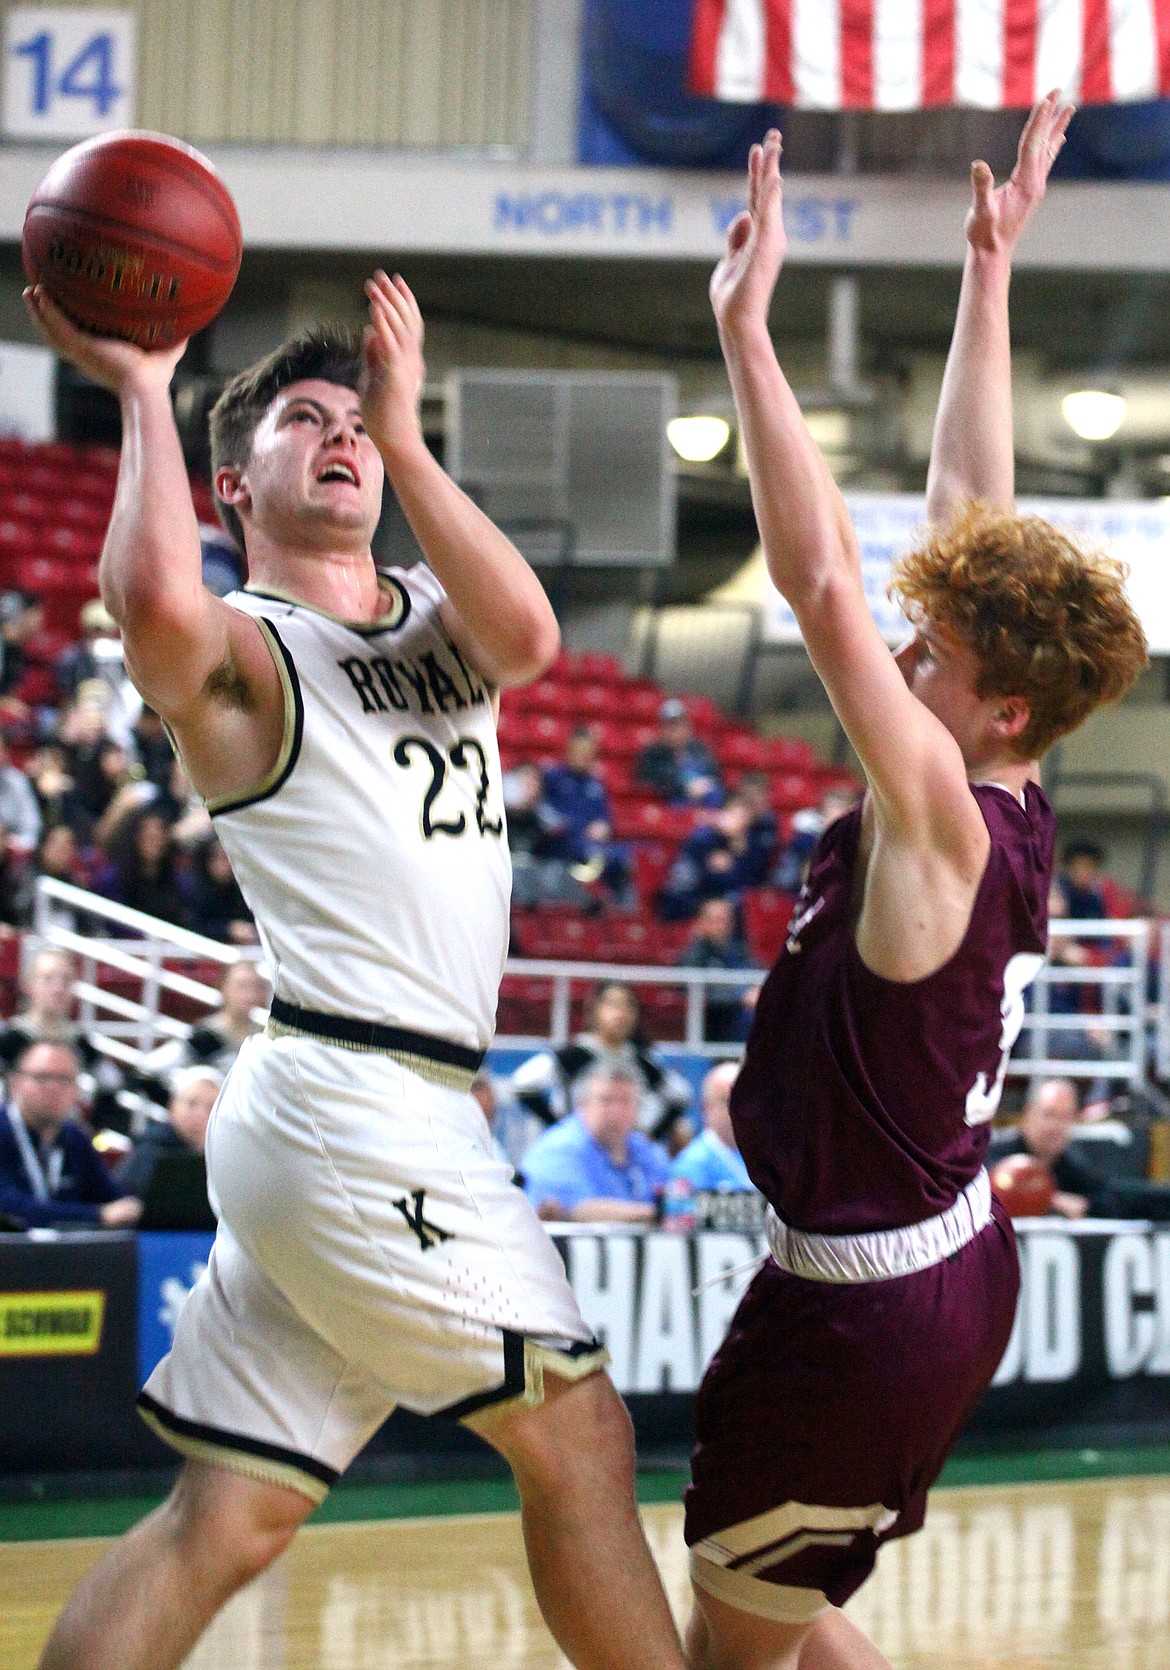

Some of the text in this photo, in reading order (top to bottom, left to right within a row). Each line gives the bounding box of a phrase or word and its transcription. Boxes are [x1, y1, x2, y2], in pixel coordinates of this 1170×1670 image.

[15, 31, 120, 116] 14
[493, 191, 857, 241] NORTH WST
[393, 735, 504, 838] 22
[391, 1187, 456, 1252] K
